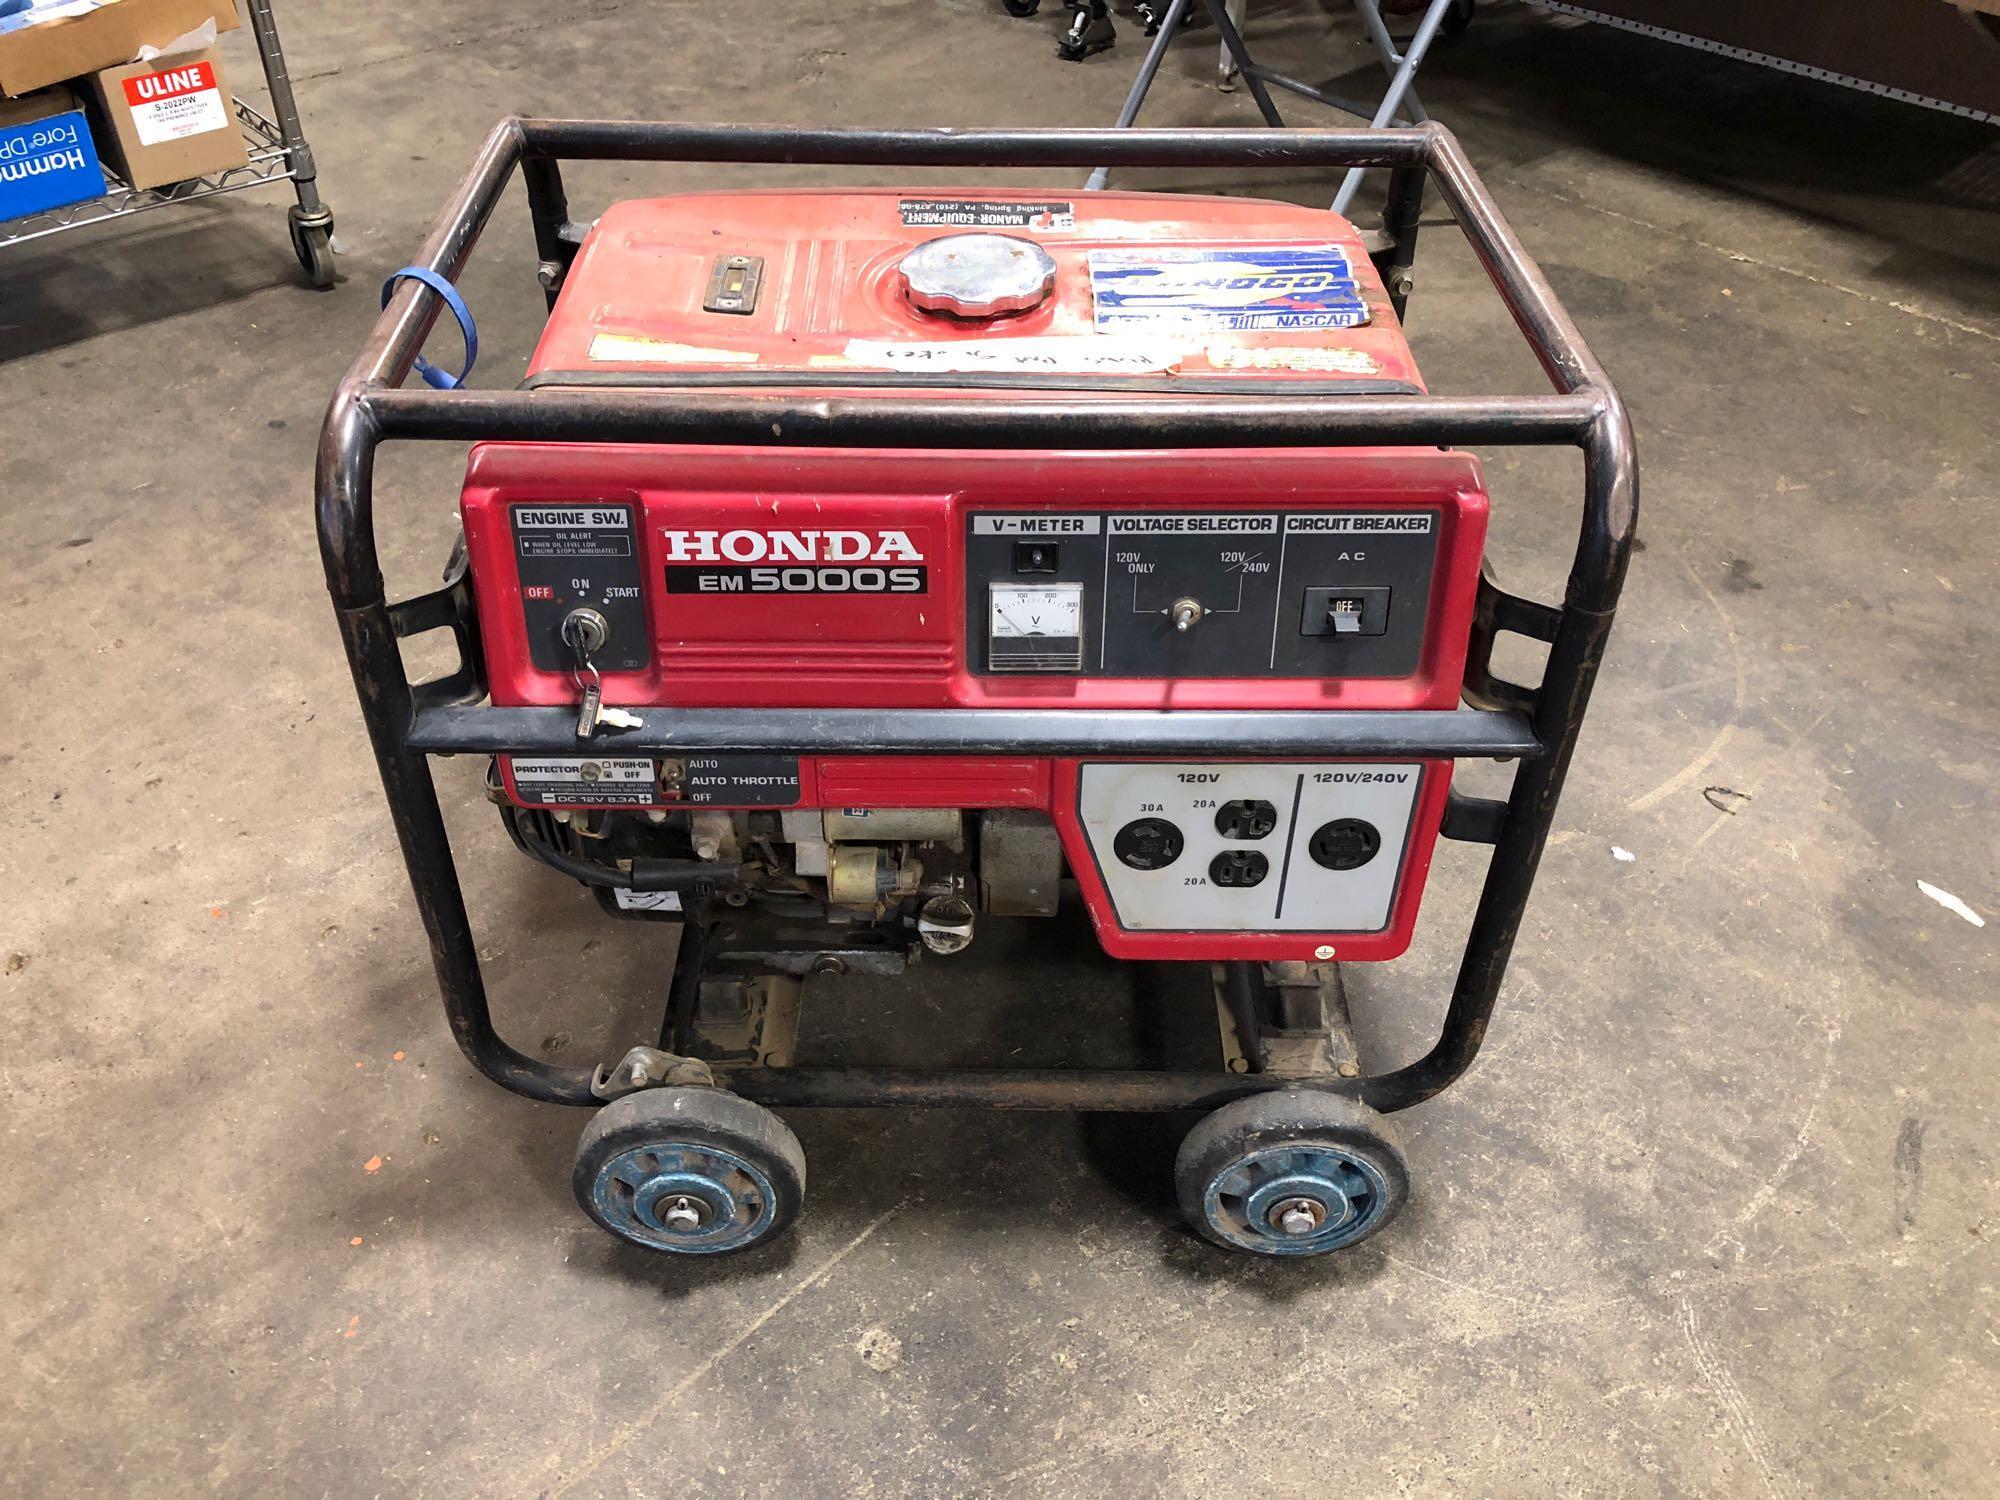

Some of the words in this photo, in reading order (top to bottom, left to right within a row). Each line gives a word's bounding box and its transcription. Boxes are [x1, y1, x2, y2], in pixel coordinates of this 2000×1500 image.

[136, 67, 203, 98] ULINE
[154, 96, 196, 112] S-2022PW
[0, 148, 86, 182] Hamm
[980, 214, 1024, 224] MANOR
[1130, 275, 1327, 291] NOCO
[1276, 313, 1352, 328] NASCAR
[520, 512, 586, 525] ENGINE
[592, 512, 624, 525] SW.
[1113, 518, 1186, 531] VOLTAGE
[1186, 518, 1272, 531] SELECTOR
[1287, 518, 1352, 531] CIRCUIT
[1353, 518, 1430, 531] BREAKER
[556, 532, 568, 540] OIL
[570, 532, 592, 540] ALERT
[664, 530, 924, 561] HONDA
[1116, 553, 1141, 564] 120V
[1220, 552, 1246, 563] 120V
[1128, 563, 1155, 574] ONLY
[1242, 562, 1270, 573] 240V
[572, 579, 590, 589] ON
[528, 588, 550, 598] OFF
[606, 588, 640, 598] START
[1336, 600, 1353, 612] OFF
[1031, 616, 1040, 625] V
[613, 761, 650, 769] PUSH-ON
[689, 760, 718, 768] AUTO
[692, 776, 727, 785] AUTO
[732, 776, 798, 785] THROTTLE
[1177, 773, 1220, 784] 120V
[1313, 773, 1408, 784] 120V/240V
[692, 793, 712, 802] OFF
